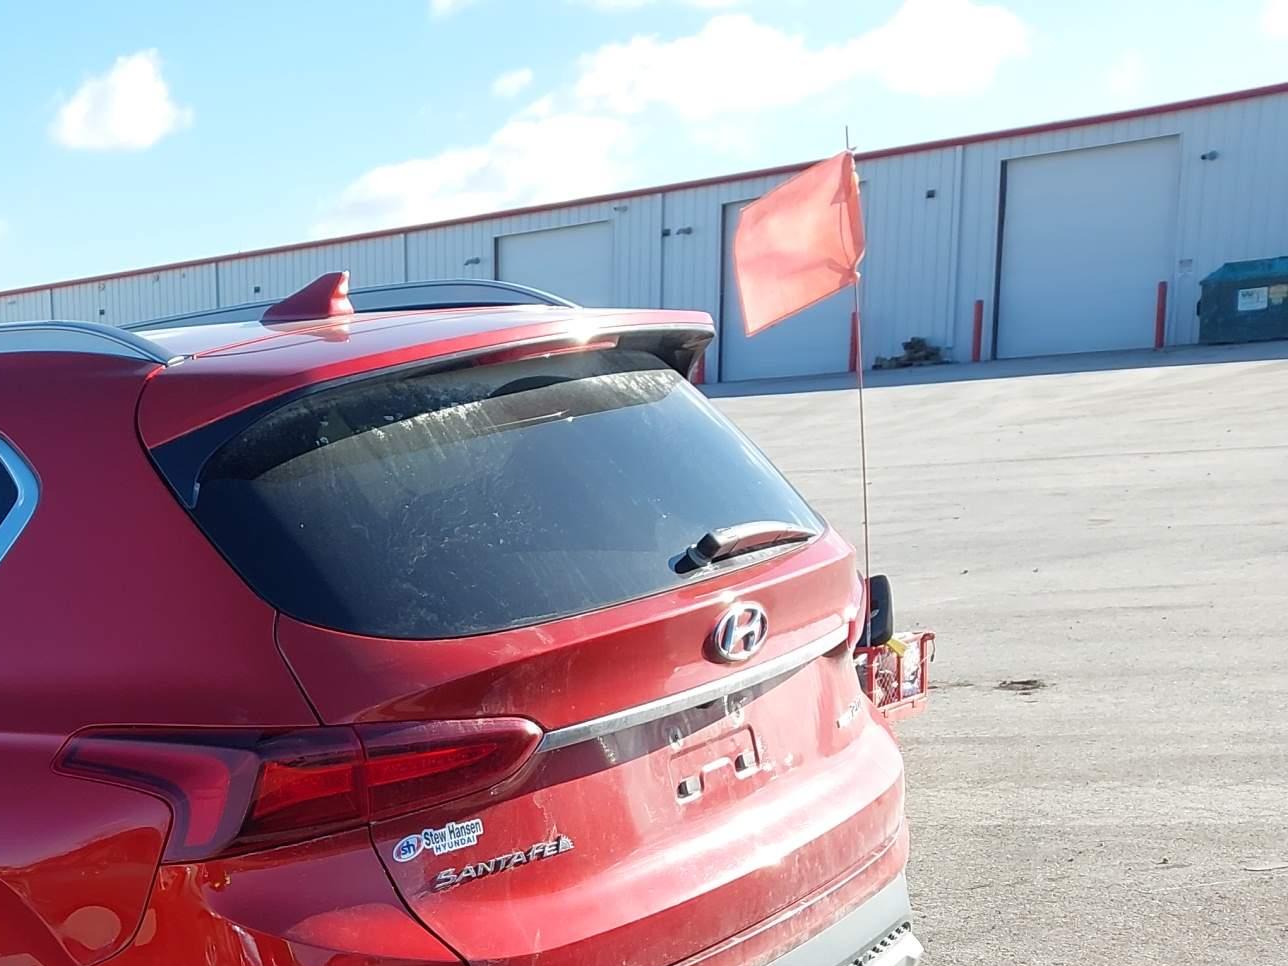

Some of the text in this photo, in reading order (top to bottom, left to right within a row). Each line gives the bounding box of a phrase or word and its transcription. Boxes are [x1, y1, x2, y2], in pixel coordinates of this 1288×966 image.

[423, 821, 481, 846] Stew Hansen
[435, 835, 475, 853] HYUNDAI
